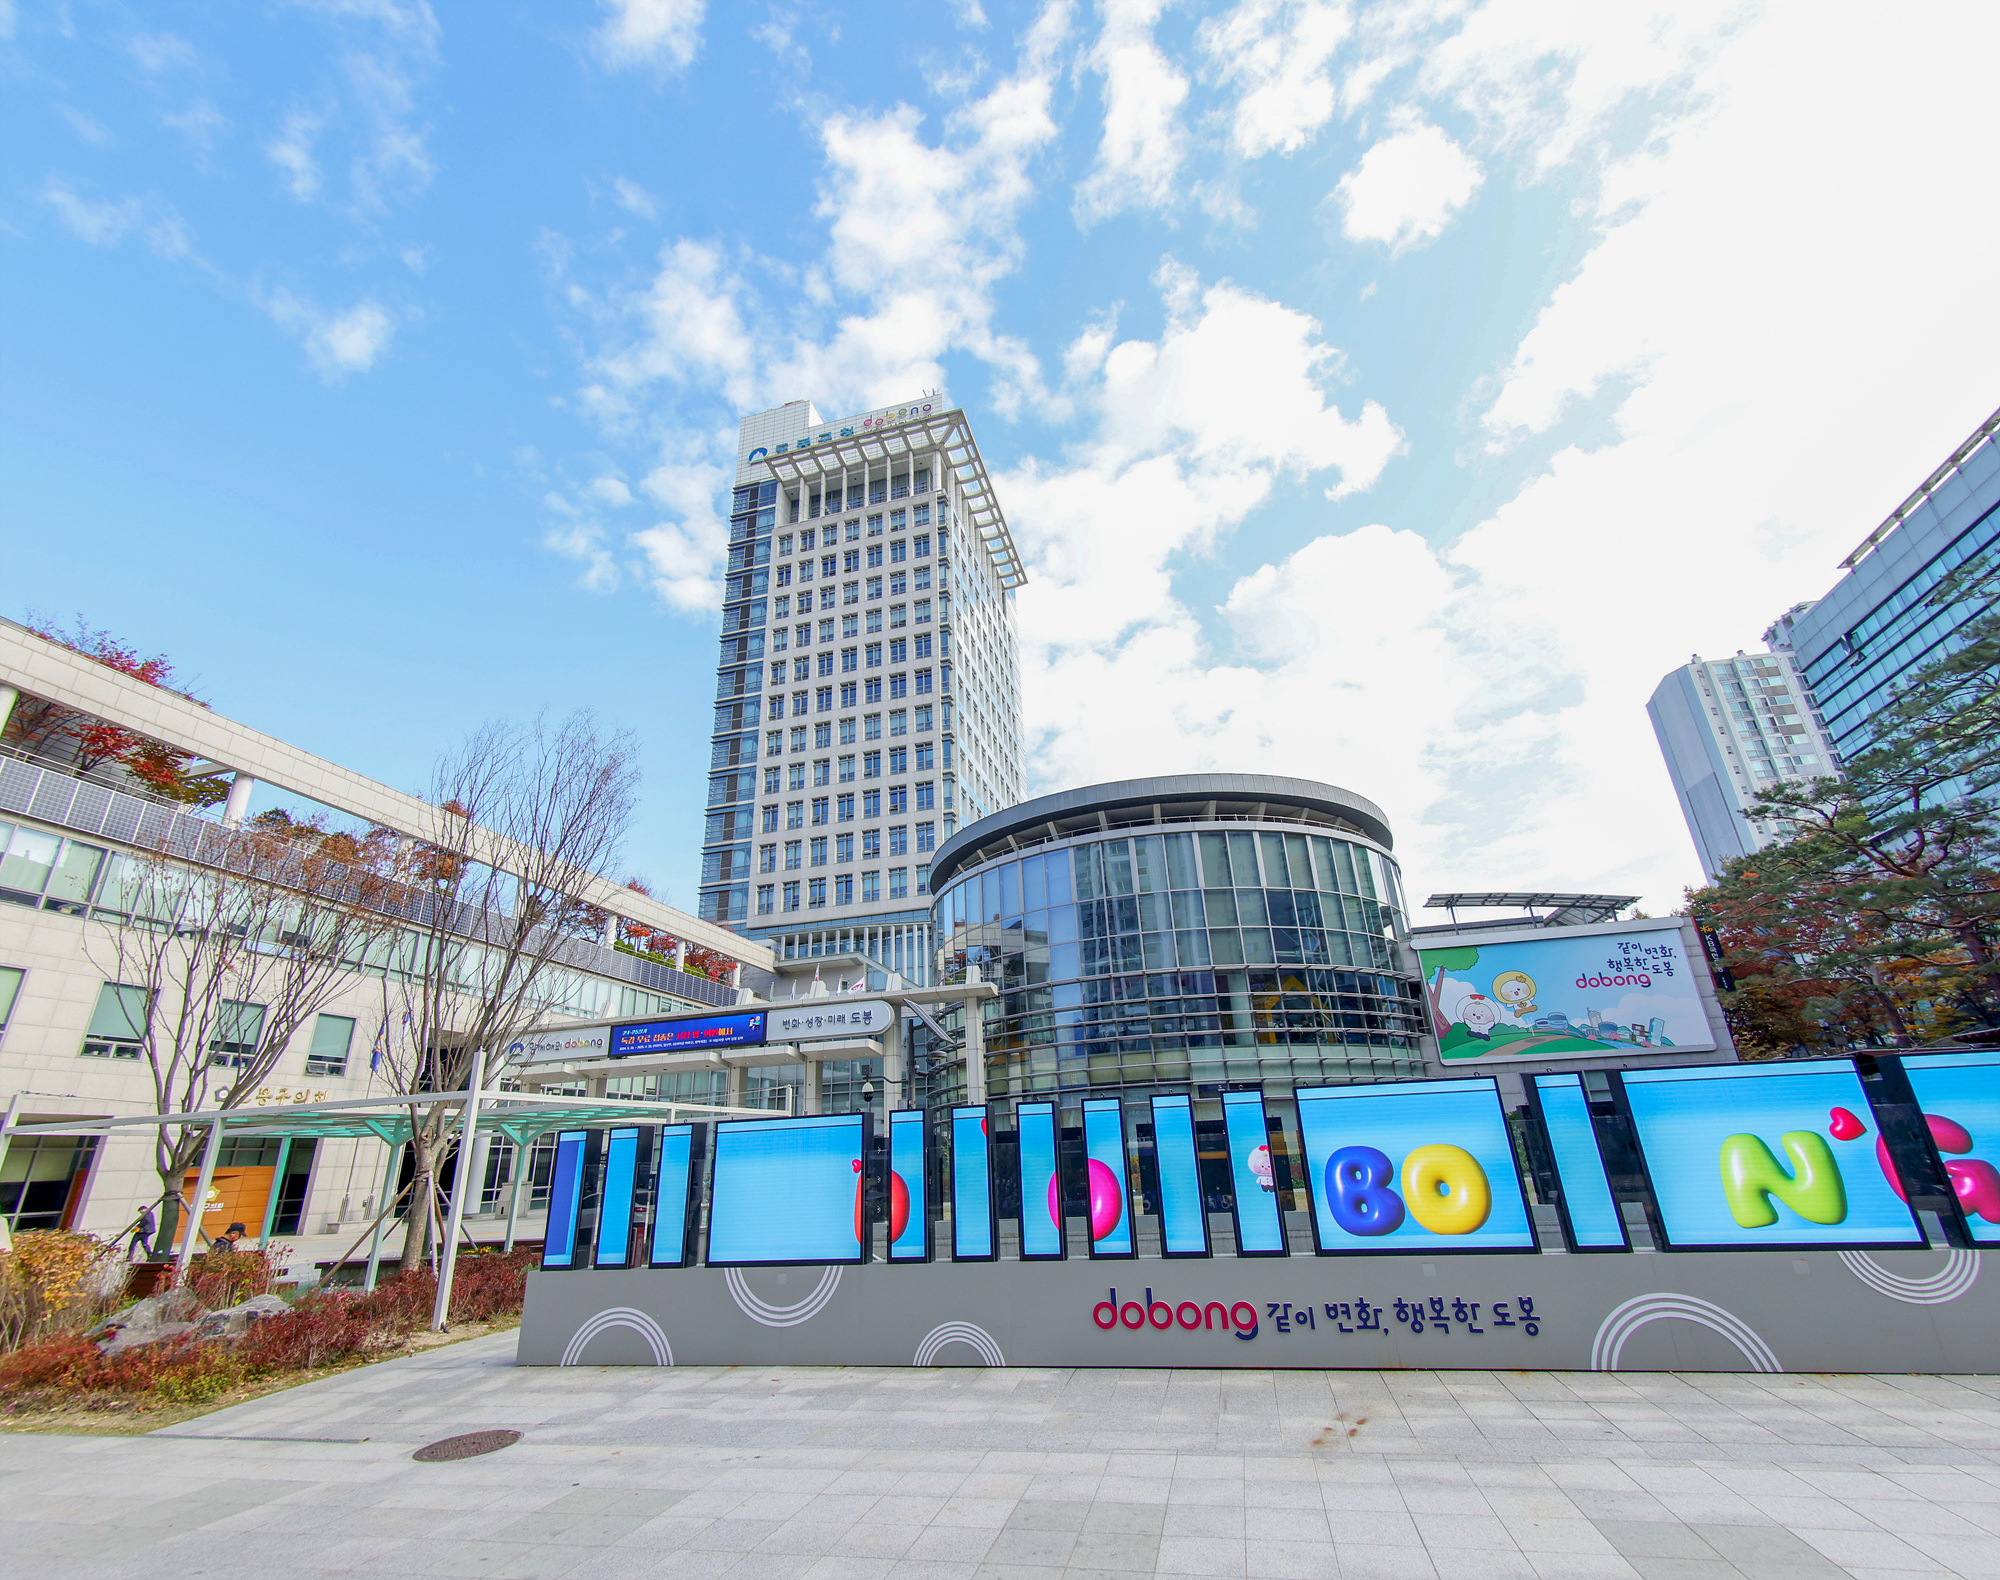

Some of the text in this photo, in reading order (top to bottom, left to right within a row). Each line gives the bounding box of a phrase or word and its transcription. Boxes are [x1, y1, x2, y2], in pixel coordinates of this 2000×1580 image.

[1617, 941, 1642, 955] 같이
[1607, 956, 1674, 977] 행복한 도봉
[1576, 973, 1651, 989] dobong
[850, 1010, 873, 1025] 도봉
[564, 1037, 603, 1049] dobong
[236, 1087, 330, 1106] 봉구의회
[1093, 1286, 1541, 1341] dobong 같이 변화, 행복한 도봉
